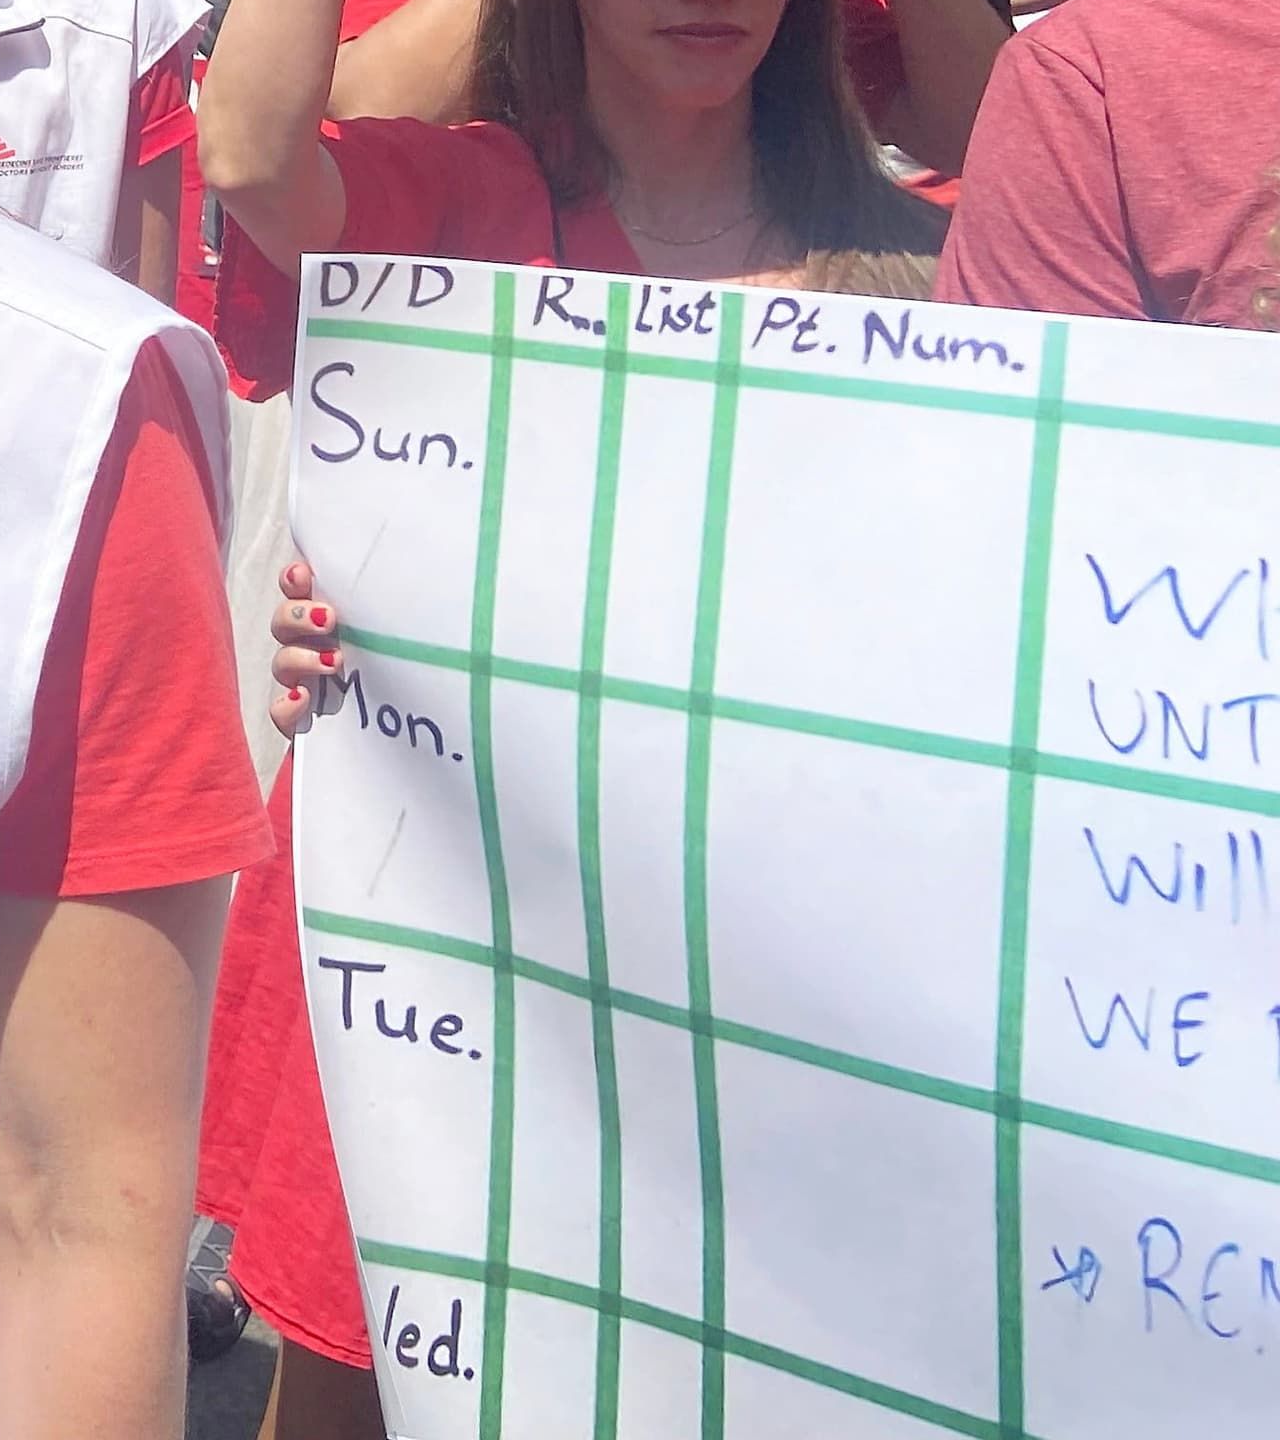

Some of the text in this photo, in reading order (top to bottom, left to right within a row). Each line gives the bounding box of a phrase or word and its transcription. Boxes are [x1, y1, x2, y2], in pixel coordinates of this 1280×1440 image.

[320, 261, 455, 312] D/D
[634, 283, 718, 335] List
[751, 296, 1025, 371] Pt. Num.
[309, 361, 474, 471] Sun.
[316, 668, 464, 762] Mon.
[318, 956, 482, 1060] Tue.
[1063, 975, 1210, 1067] WE
